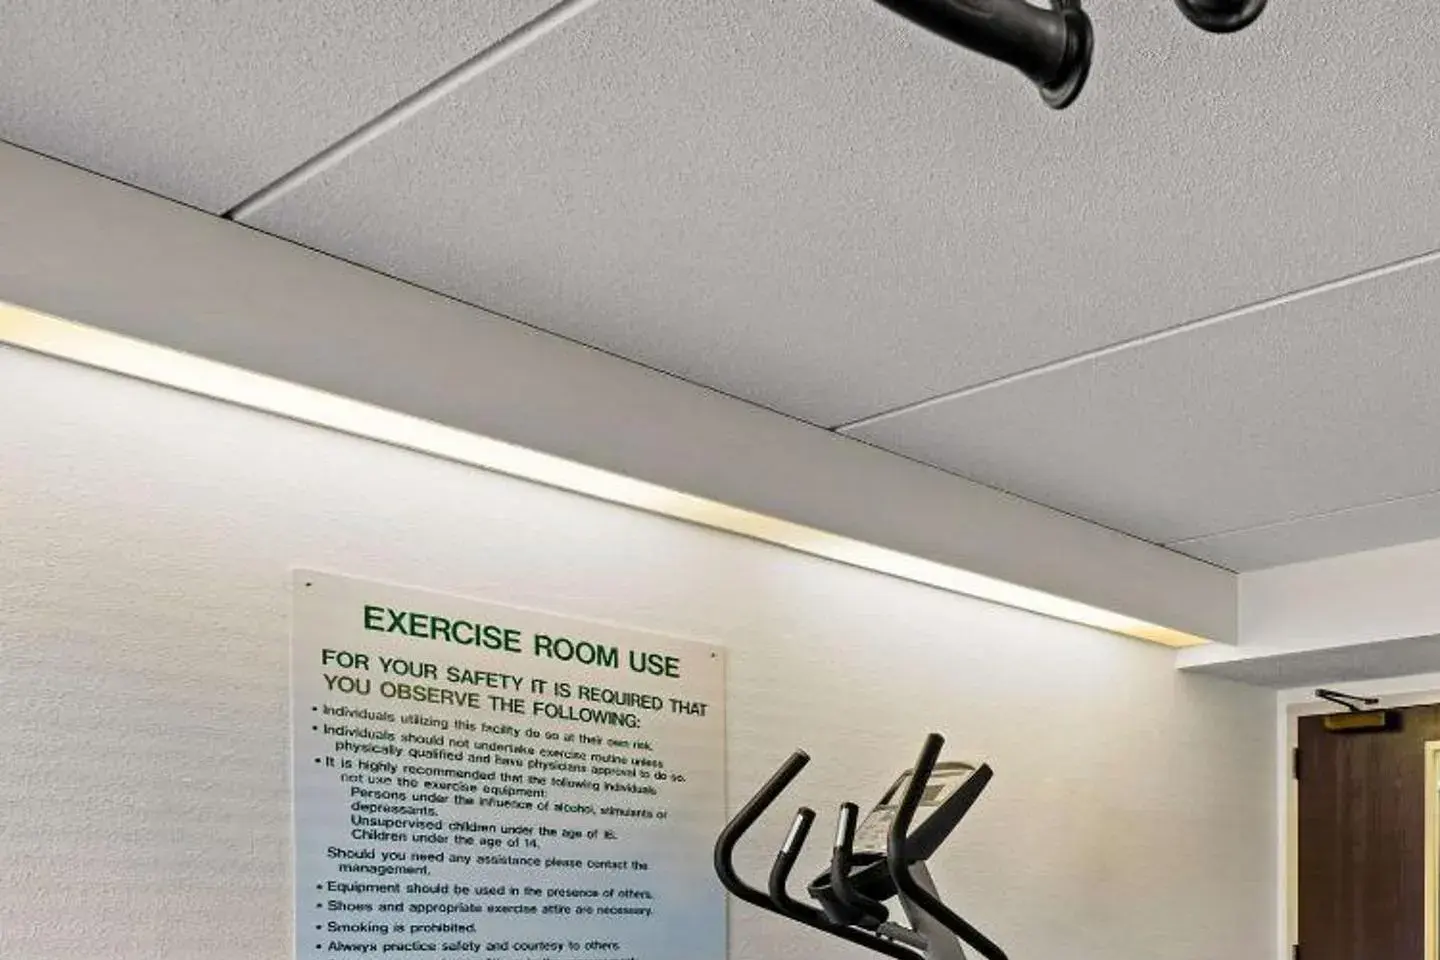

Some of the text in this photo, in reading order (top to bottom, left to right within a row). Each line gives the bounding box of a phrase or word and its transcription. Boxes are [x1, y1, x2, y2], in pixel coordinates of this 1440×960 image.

[364, 605, 680, 678] EXERCISE ROOM USE
[322, 649, 709, 717] FOR YOUR SAFETY IT IS REQUIRED THAT
[323, 673, 641, 729] YOU OBSERVE THE FOLLOWING:
[323, 704, 395, 723] Individuals
[401, 713, 449, 730] utilizing
[454, 718, 476, 732] this
[525, 727, 540, 738] do
[579, 733, 602, 746] their
[324, 724, 396, 742] Individuals
[401, 732, 444, 746] should
[449, 738, 469, 749] not
[474, 740, 535, 756] undertake
[540, 747, 586, 761] exercise
[325, 756, 336, 768] It
[341, 758, 352, 769] is
[358, 759, 398, 775] highly
[403, 764, 496, 782] recommended
[500, 772, 524, 784] that
[335, 740, 402, 757] physically
[408, 746, 464, 762] qualified
[467, 751, 490, 764] and
[654, 770, 667, 781] do
[341, 773, 363, 783] not
[397, 776, 418, 788] the
[423, 780, 477, 794] exercise
[351, 786, 406, 801] Persons
[412, 791, 448, 804] under
[454, 794, 475, 805] the
[537, 800, 549, 811] of
[351, 800, 438, 816] depressants.
[351, 814, 442, 831] Unsupervised
[448, 821, 496, 833] children
[500, 824, 534, 836] under
[539, 826, 557, 837] the
[562, 829, 582, 840] age
[587, 829, 598, 840] of
[351, 829, 407, 842] Children
[412, 833, 448, 844] under
[454, 834, 475, 846] the
[480, 837, 502, 848] age
[507, 838, 520, 848] of
[327, 846, 648, 870] Should you need any assistance please contact the
[327, 880, 400, 894] Equipment
[406, 883, 448, 895] should
[454, 883, 470, 895] be
[474, 885, 505, 896] used
[508, 885, 519, 896] in
[524, 885, 542, 897] the
[546, 887, 598, 899] presence
[602, 887, 614, 898] of
[327, 900, 373, 912] Shoes
[378, 902, 404, 912] and
[408, 901, 482, 914] appropriate
[487, 903, 538, 915] exercise
[541, 903, 571, 914] attire
[575, 904, 593, 914] are
[327, 920, 389, 935] Smoking
[393, 922, 405, 932] is
[327, 941, 377, 953] Always
[383, 941, 437, 952] practice
[442, 940, 481, 953] safety
[486, 940, 508, 951] and
[568, 941, 580, 951] to
